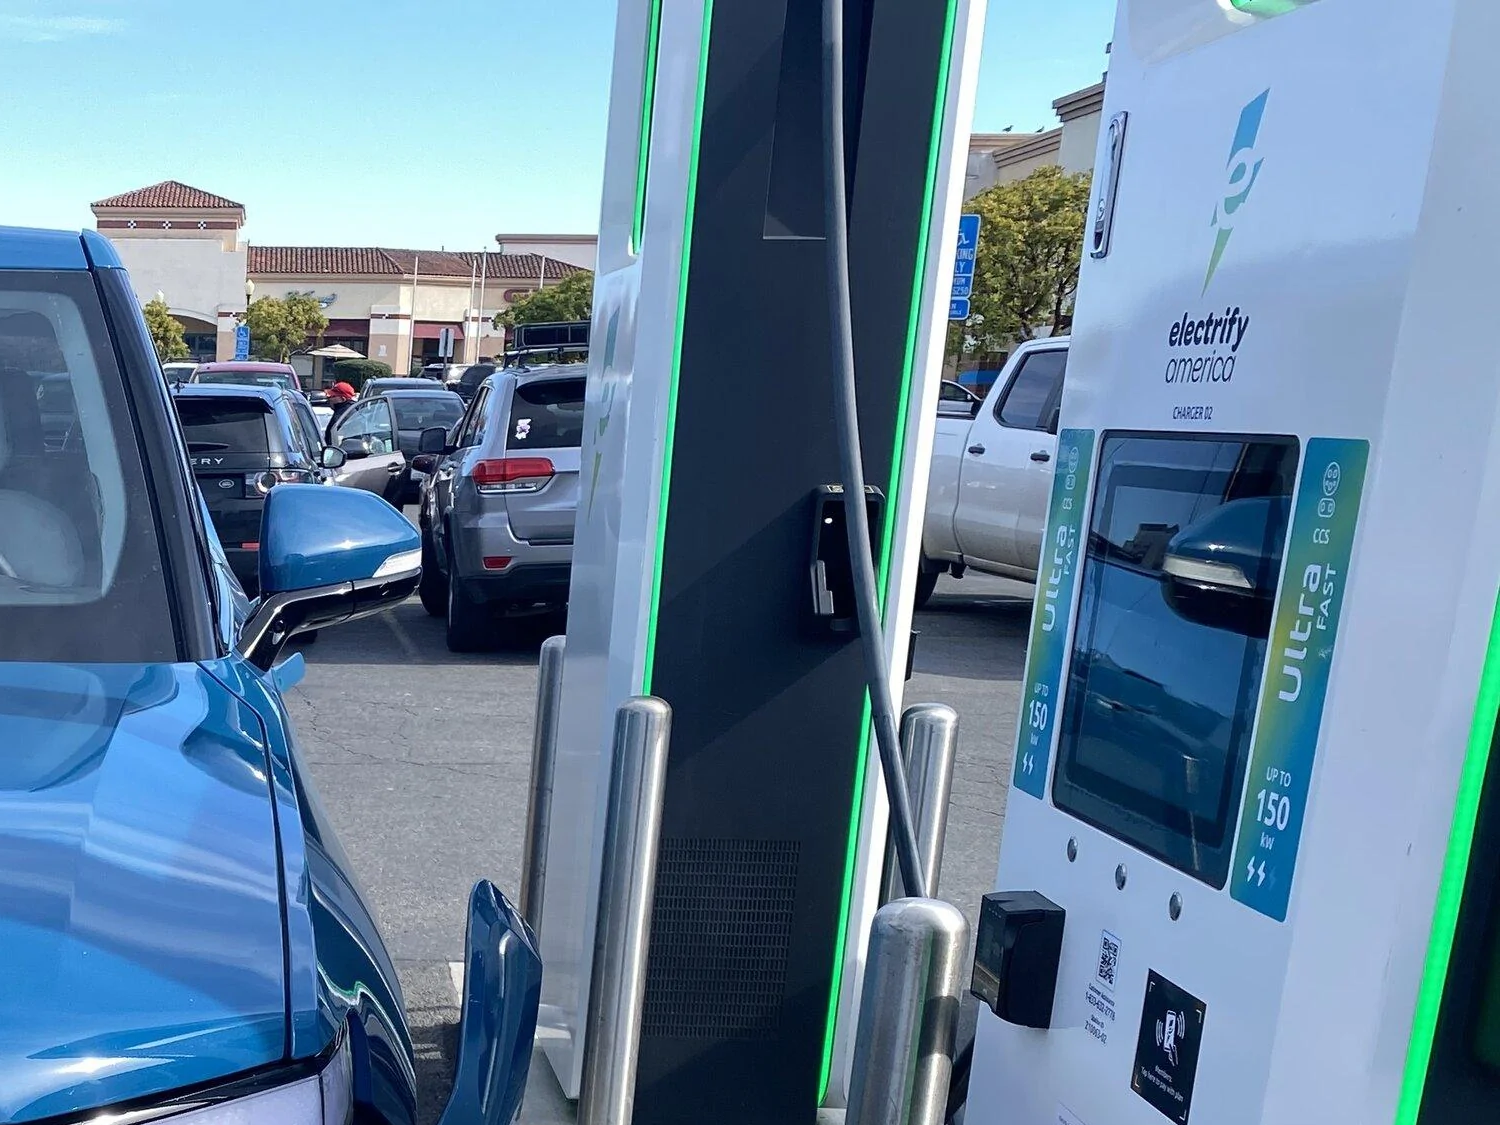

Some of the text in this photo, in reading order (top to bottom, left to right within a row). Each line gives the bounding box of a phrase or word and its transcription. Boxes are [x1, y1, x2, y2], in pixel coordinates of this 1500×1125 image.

[1169, 307, 1249, 352] electrify
[1165, 349, 1236, 383] america
[1172, 406, 1214, 420] CHARGER 02
[1063, 524, 1076, 575] FAST
[1042, 525, 1068, 632] Ultra
[1316, 563, 1337, 630] FAST
[1278, 563, 1322, 702] Ultra
[1028, 699, 1048, 731] 150
[1266, 766, 1291, 787] UP TO
[1257, 788, 1290, 831] 150
[1260, 831, 1275, 850] kW
